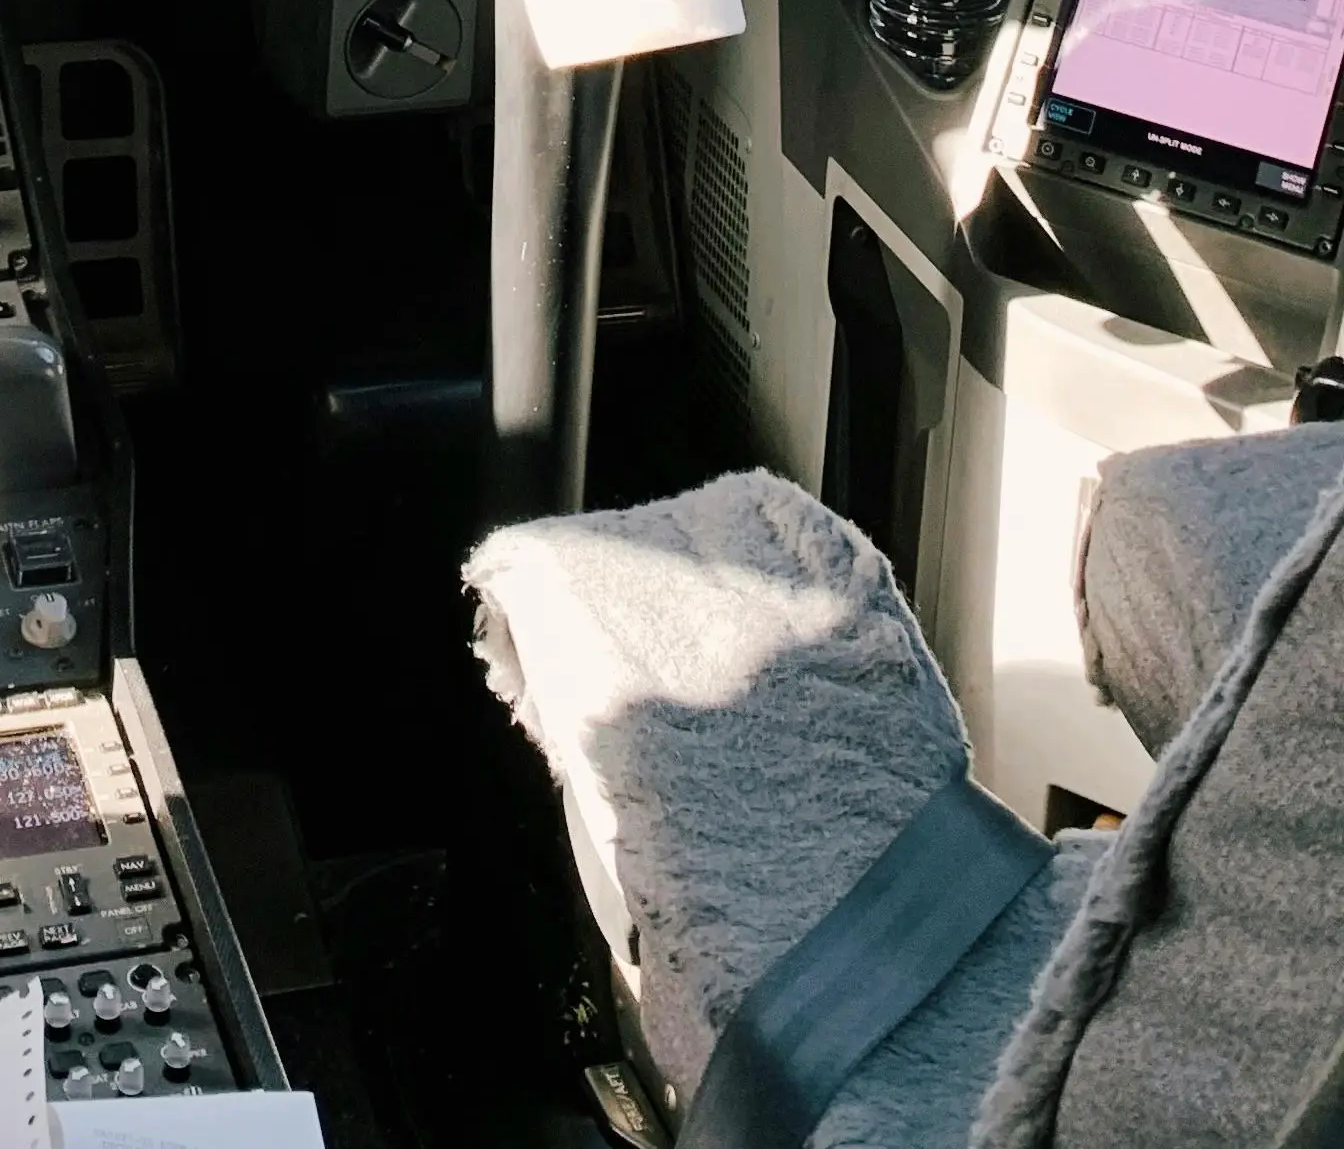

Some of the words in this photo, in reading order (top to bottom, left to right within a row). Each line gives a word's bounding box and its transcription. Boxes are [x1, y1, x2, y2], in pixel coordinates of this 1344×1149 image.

[1180, 141, 1203, 156] MODE
[120, 860, 145, 872] NAV
[124, 881, 157, 893] MENU
[43, 925, 69, 937] NEXT
